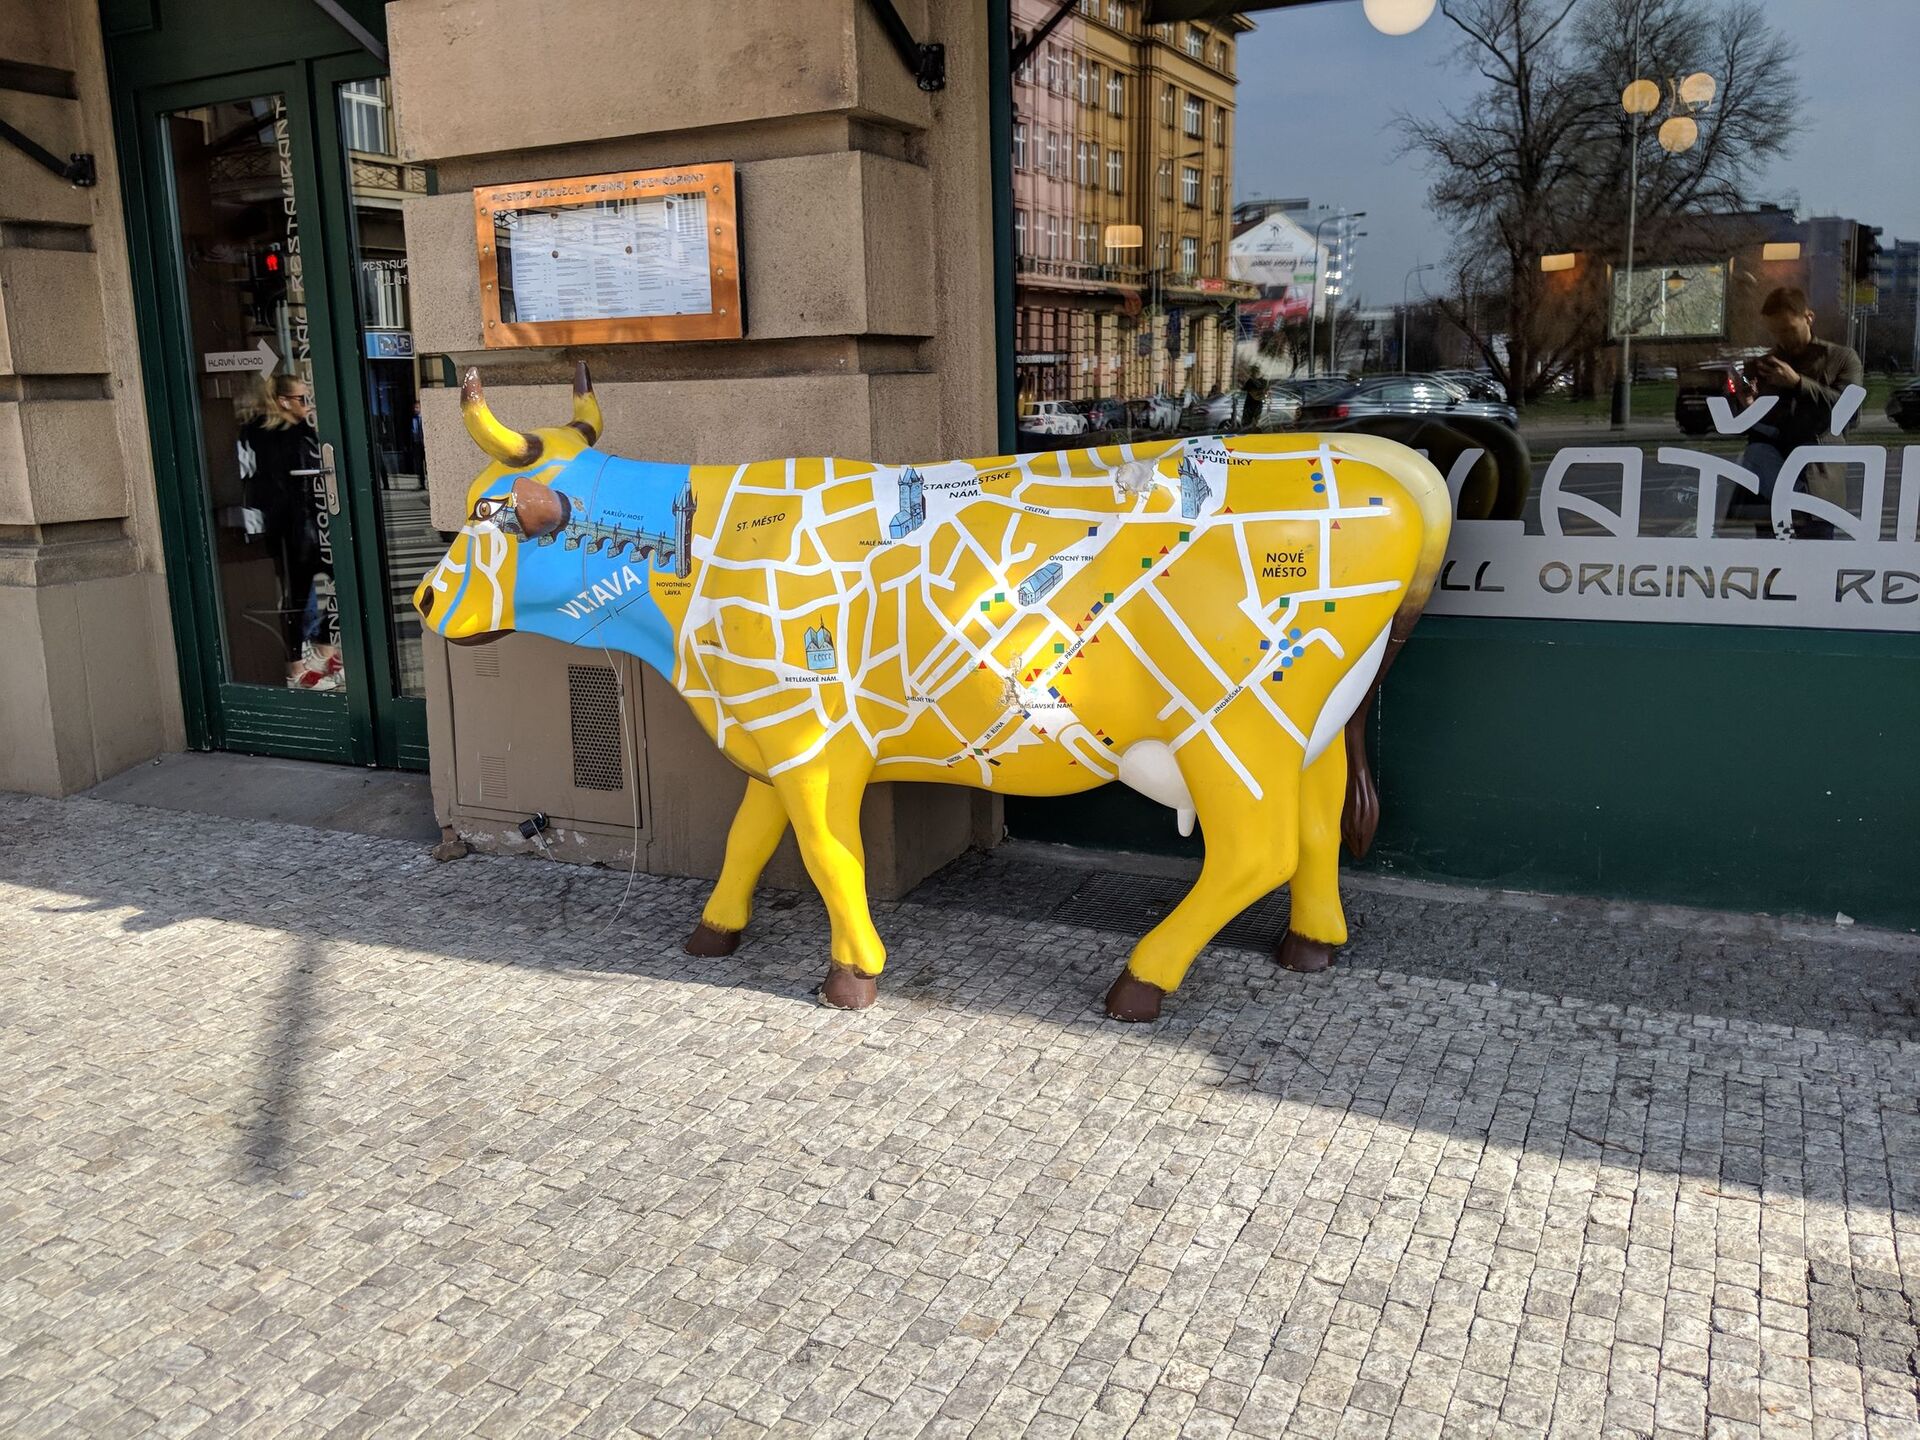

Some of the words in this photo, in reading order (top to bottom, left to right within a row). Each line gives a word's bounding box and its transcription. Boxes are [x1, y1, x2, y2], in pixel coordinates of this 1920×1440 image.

[273, 96, 304, 292] RESTAURANT
[237, 357, 263, 366] VCHOD
[948, 488, 982, 499] NÁM.
[627, 513, 645, 521] MOST
[736, 522, 749, 532] ST.
[751, 512, 786, 528] MĚSTO
[1266, 550, 1304, 563] NOVÉ
[1262, 565, 1307, 577] MĚSTO
[656, 580, 692, 588] NOVOTNÉHO
[1538, 561, 1797, 601] ORIGINAL
[556, 565, 642, 619] VLTAVA
[1054, 661, 1064, 670] NA
